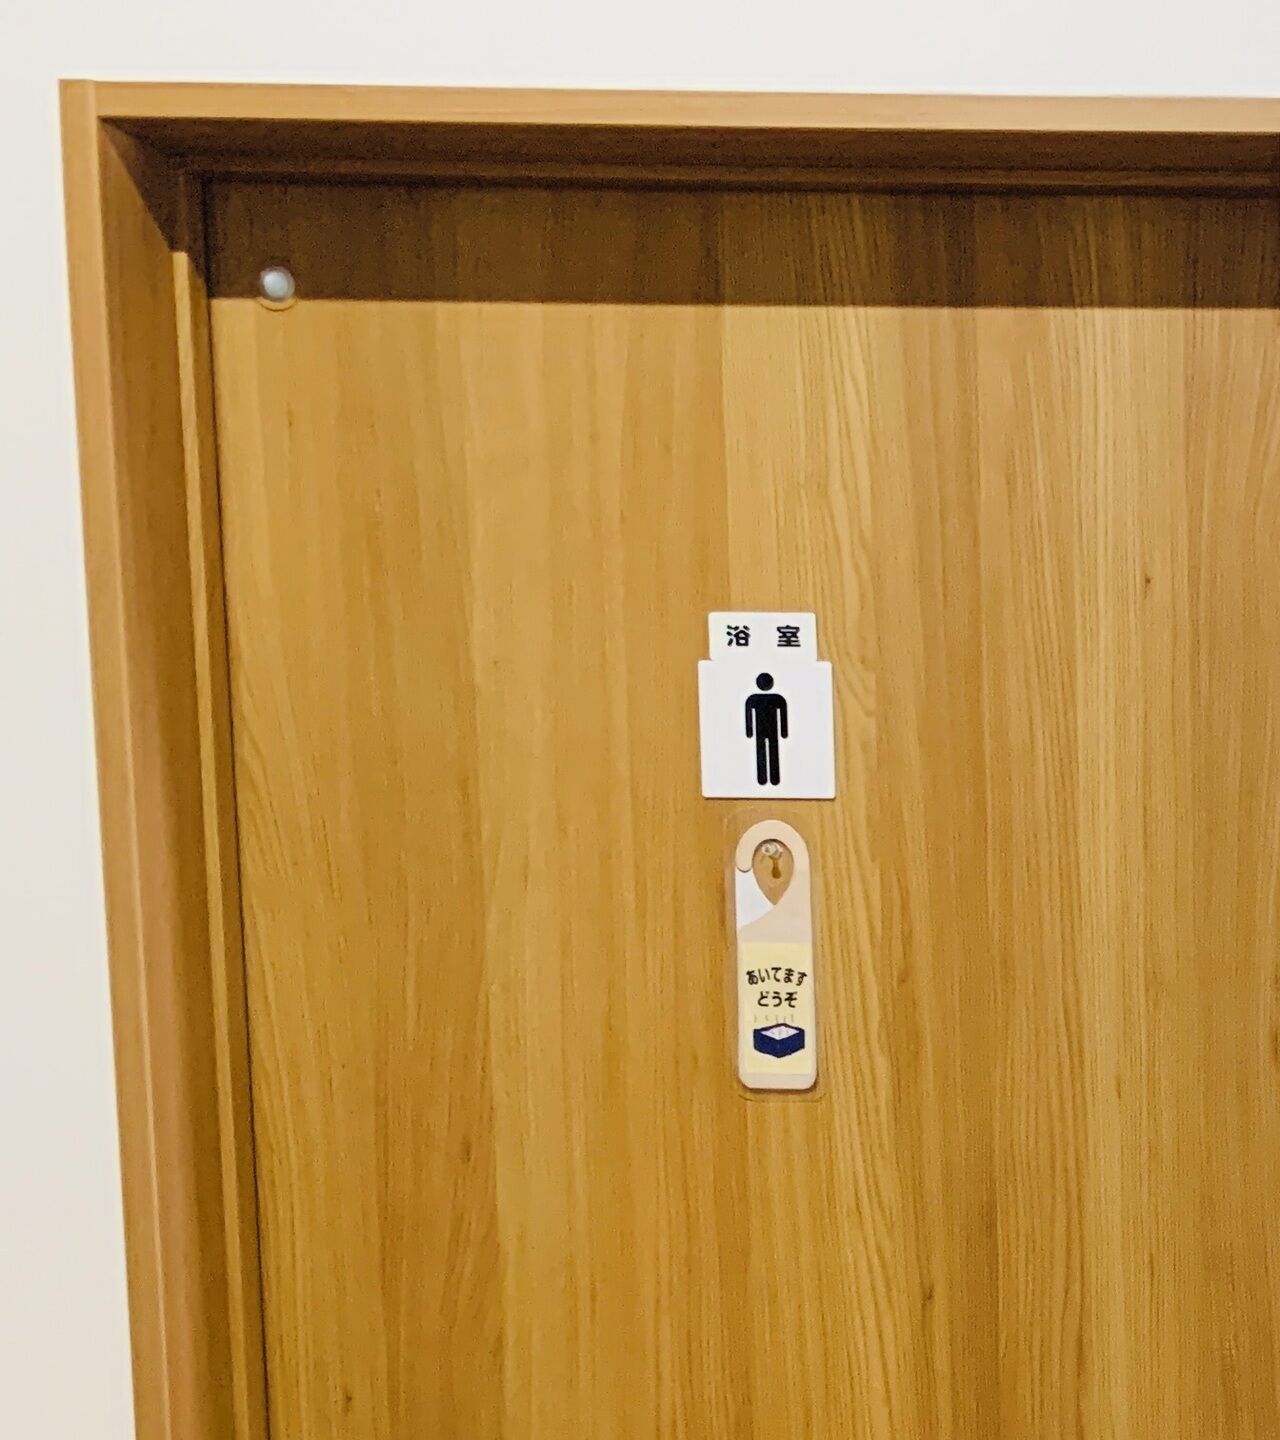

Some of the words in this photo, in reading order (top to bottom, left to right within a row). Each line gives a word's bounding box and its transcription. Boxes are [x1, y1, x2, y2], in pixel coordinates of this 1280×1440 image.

[746, 966, 807, 986] あいてます
[757, 991, 798, 1008] どうぞ
